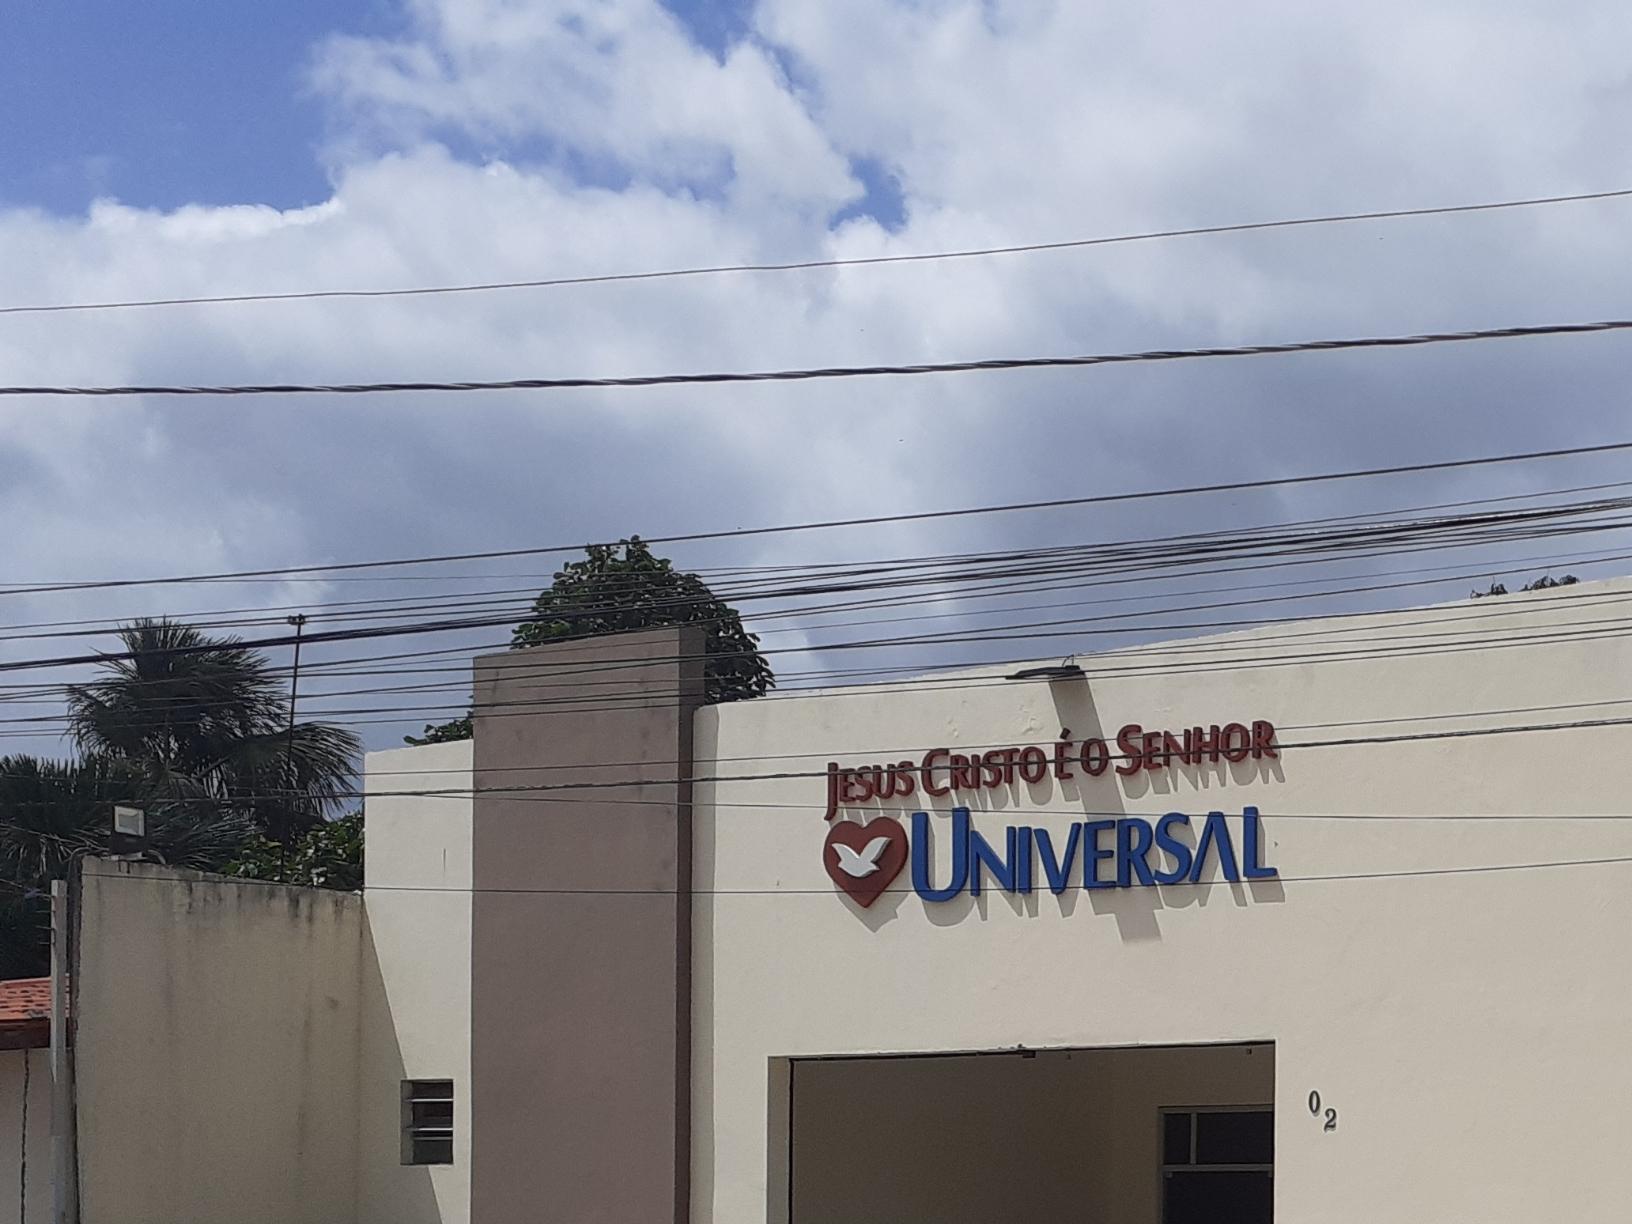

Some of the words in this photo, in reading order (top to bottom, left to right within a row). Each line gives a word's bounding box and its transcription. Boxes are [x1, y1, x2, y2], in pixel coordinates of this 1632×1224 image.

[824, 760, 914, 820] JESUS
[921, 746, 1046, 797] CRISTO
[1054, 728, 1074, 780] É
[1080, 738, 1109, 776] O
[1115, 720, 1278, 776] SENHOR
[911, 806, 1278, 902] UNIVERSAL
[1308, 1090, 1337, 1133] 02
